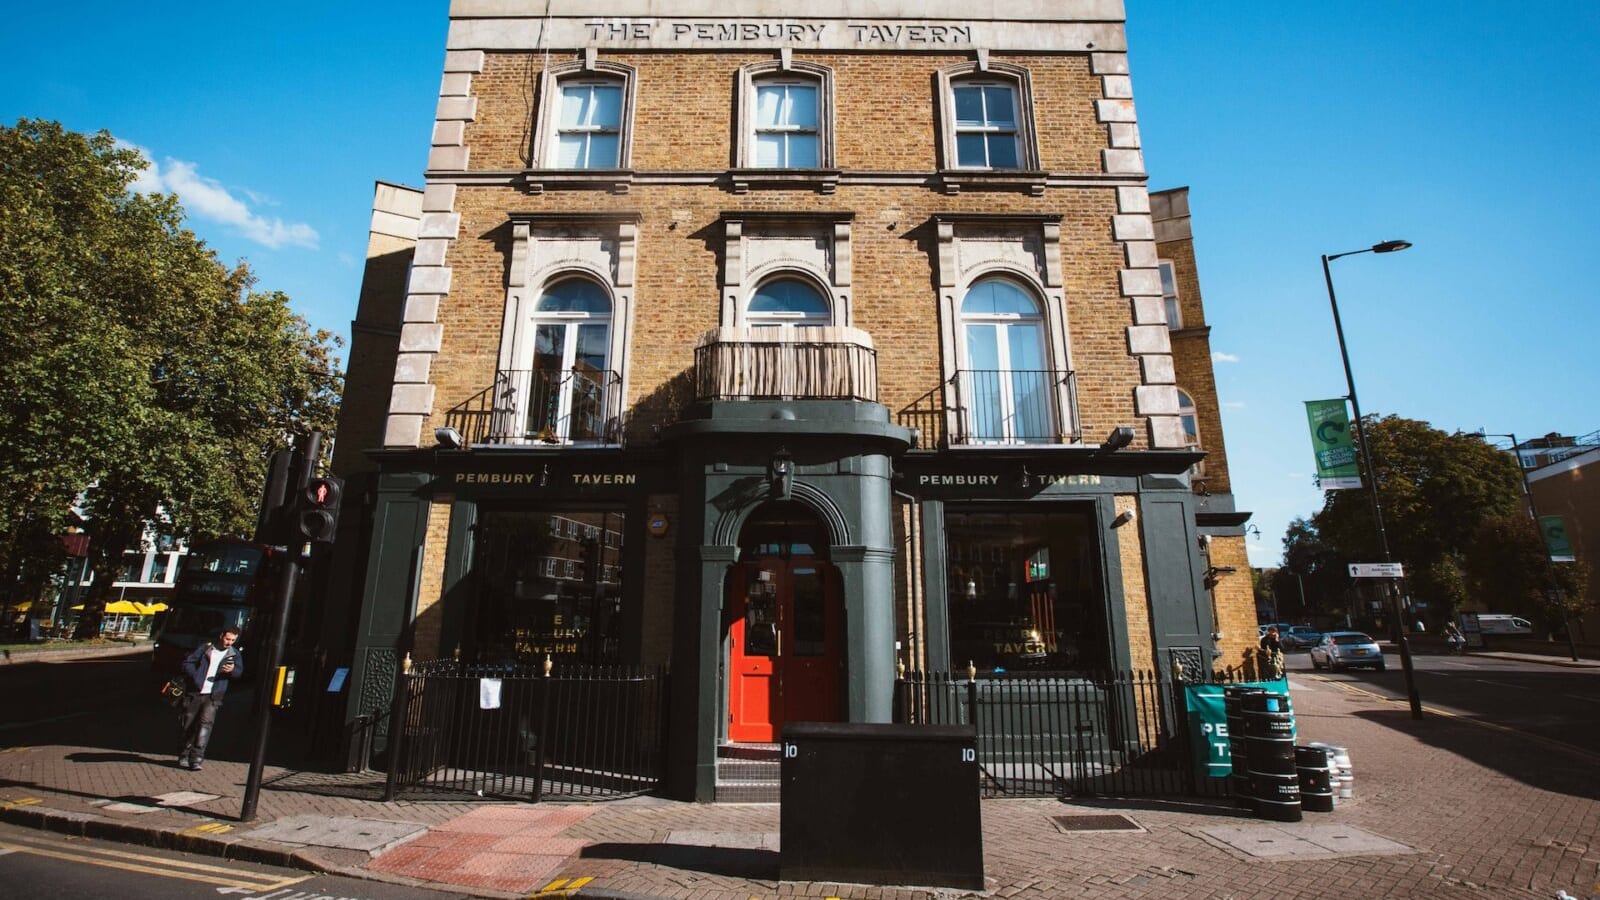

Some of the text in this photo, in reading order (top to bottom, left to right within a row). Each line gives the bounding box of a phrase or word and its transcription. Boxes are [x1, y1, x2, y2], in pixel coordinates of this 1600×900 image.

[584, 23, 972, 44] THE PEMBURY TAVERN
[455, 473, 637, 485] PEMBURY TAVERN
[919, 474, 1101, 486] PEMBURY TAVERN
[993, 643, 1059, 654] TAVERN
[962, 748, 976, 762] 10
